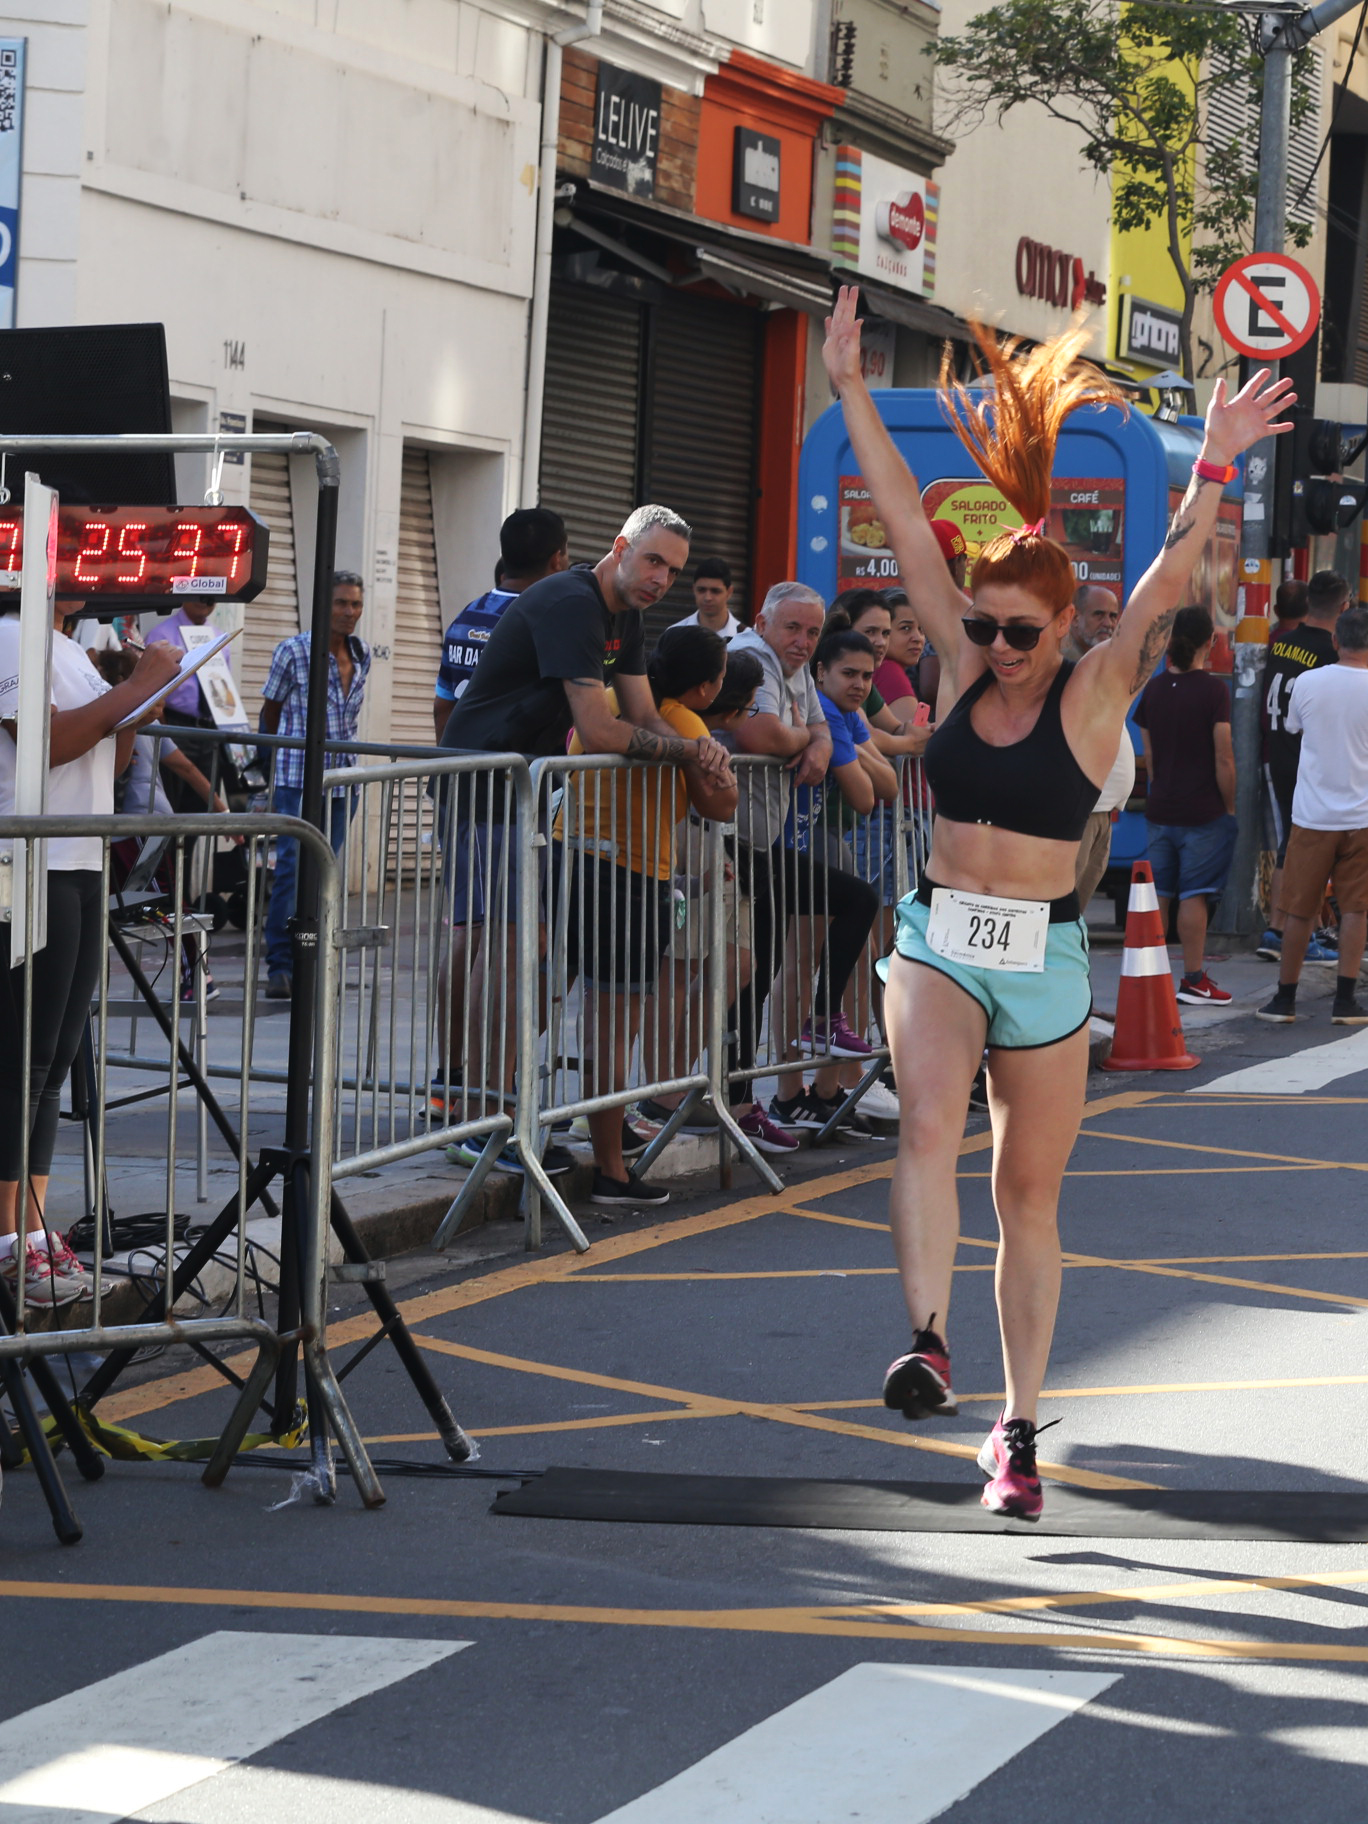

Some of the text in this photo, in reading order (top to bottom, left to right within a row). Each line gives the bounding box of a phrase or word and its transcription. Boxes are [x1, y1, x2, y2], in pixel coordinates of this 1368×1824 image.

[598, 91, 657, 157] LELIVE
[890, 206, 921, 237] demonte
[1248, 276, 1287, 338] E
[223, 339, 246, 371] 1144
[951, 500, 1007, 512] SALGADO
[1070, 490, 1100, 504] CAFÉ
[963, 514, 998, 525] FRITO
[74, 523, 146, 582] 25
[866, 559, 898, 579] 4,00
[190, 578, 225, 589] Global
[449, 644, 479, 667] BAR DA
[967, 915, 1011, 952] 234
